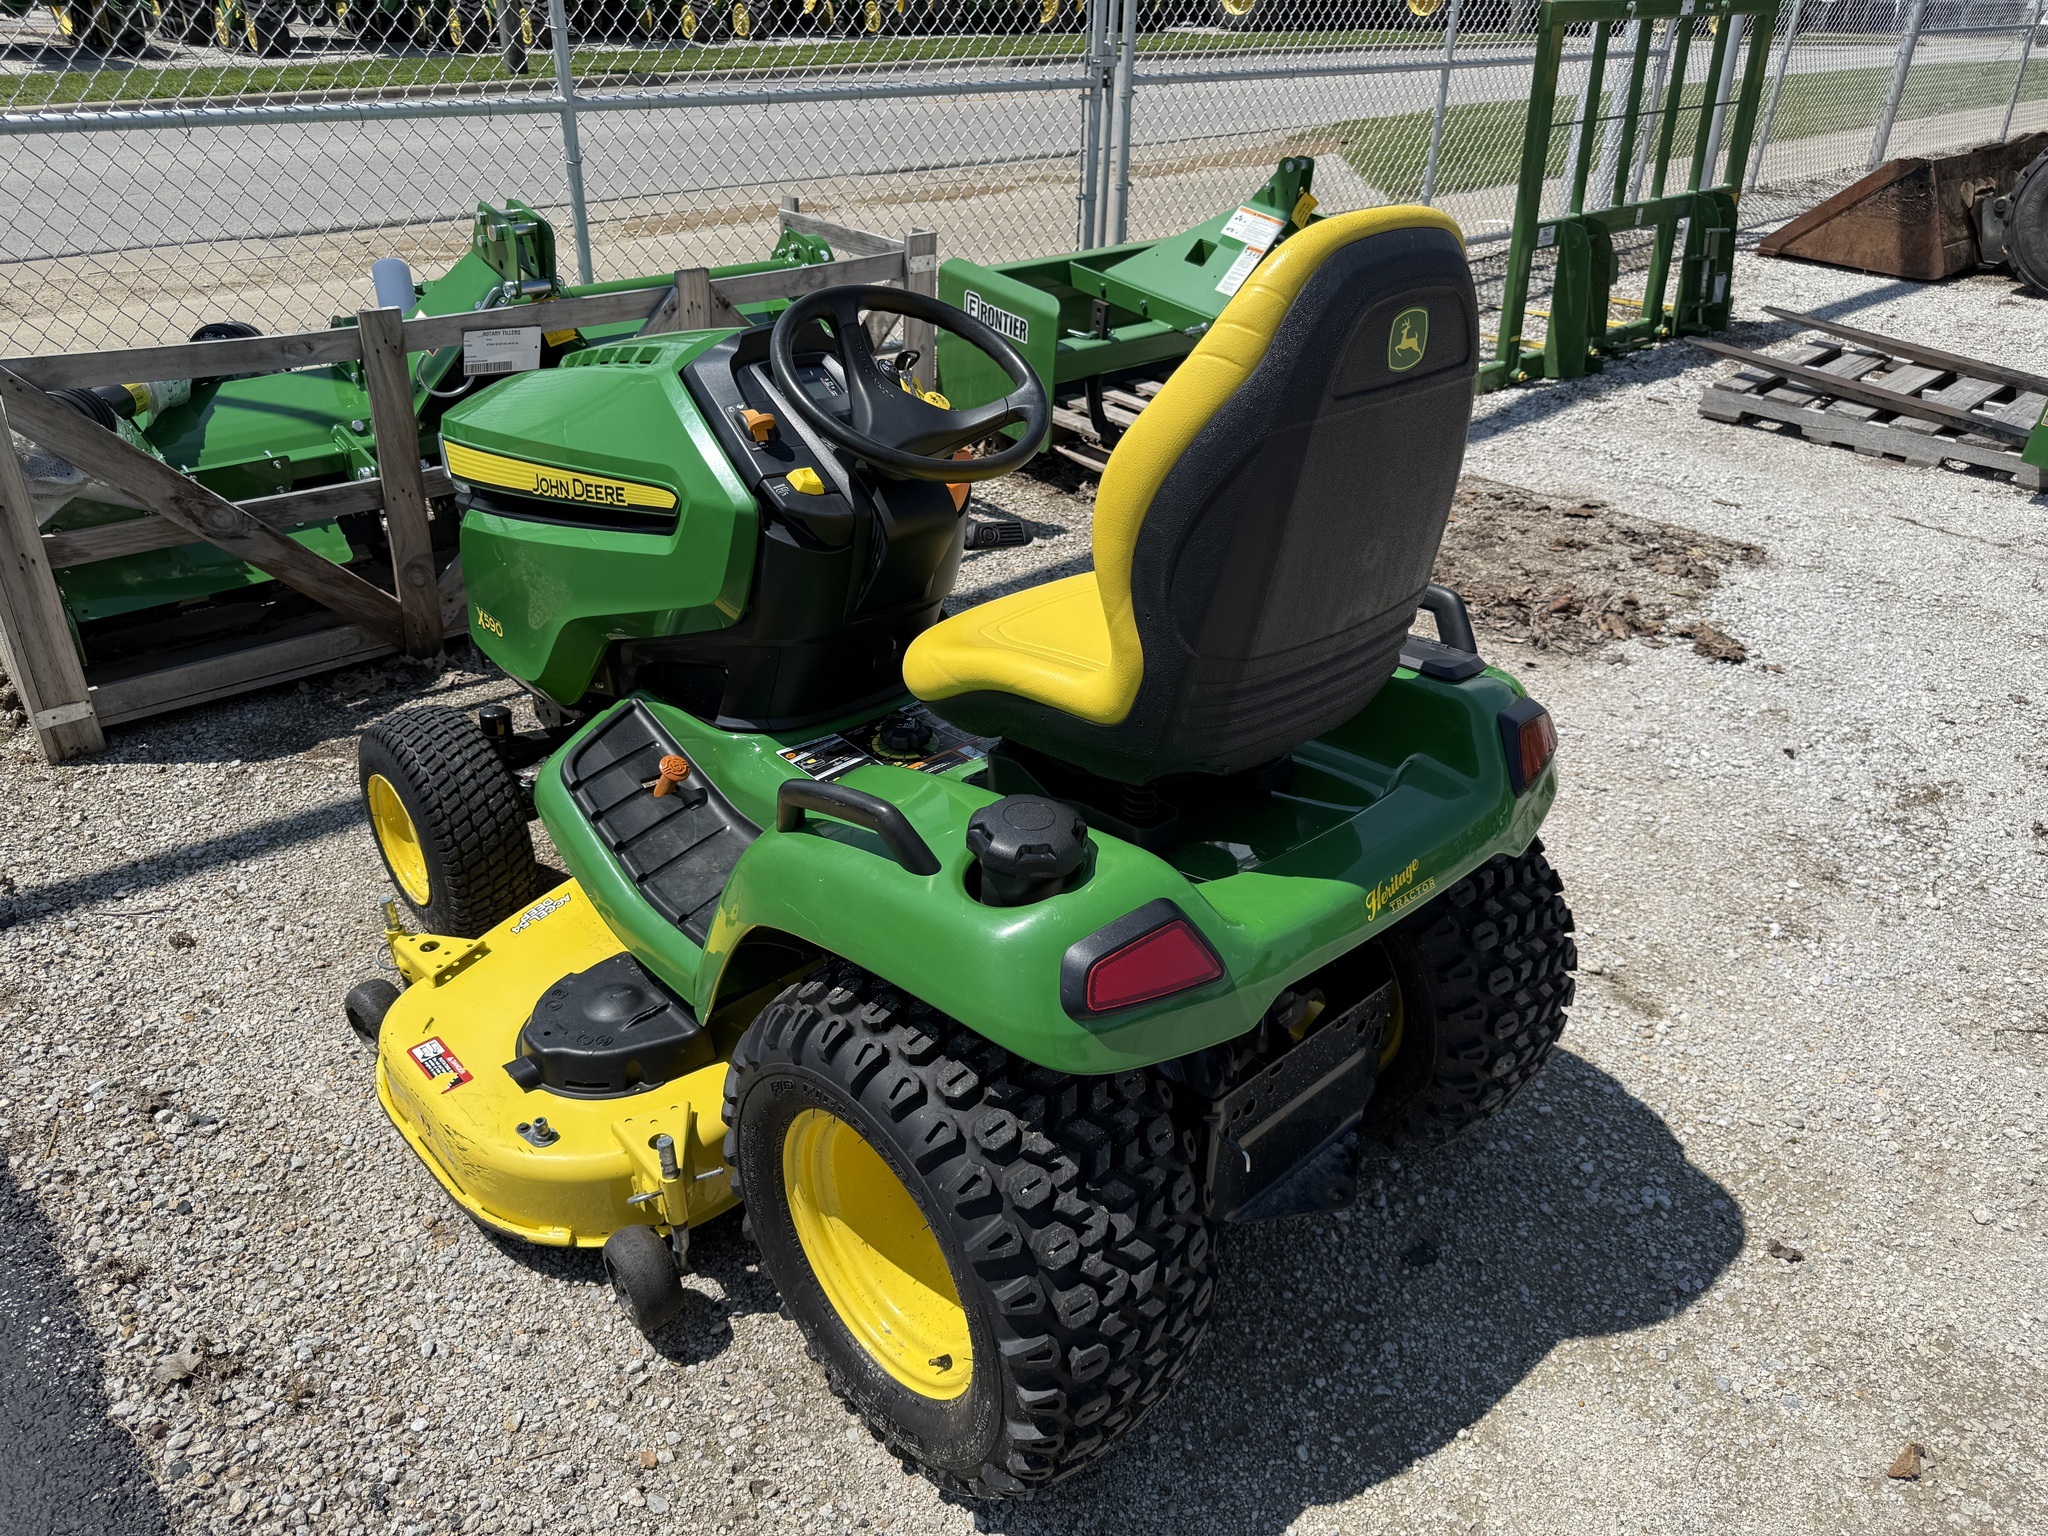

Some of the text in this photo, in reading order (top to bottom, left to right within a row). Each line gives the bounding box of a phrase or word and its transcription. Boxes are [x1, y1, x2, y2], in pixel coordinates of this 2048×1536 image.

[966, 291, 1028, 342] FRONTIER
[533, 473, 628, 505] JOHN DEERE
[476, 606, 504, 639] X590
[1365, 858, 1419, 922] Heritage
[1389, 878, 1437, 912] TRACTOR
[520, 897, 555, 922] DEEP
[529, 893, 571, 921] ACCEL
